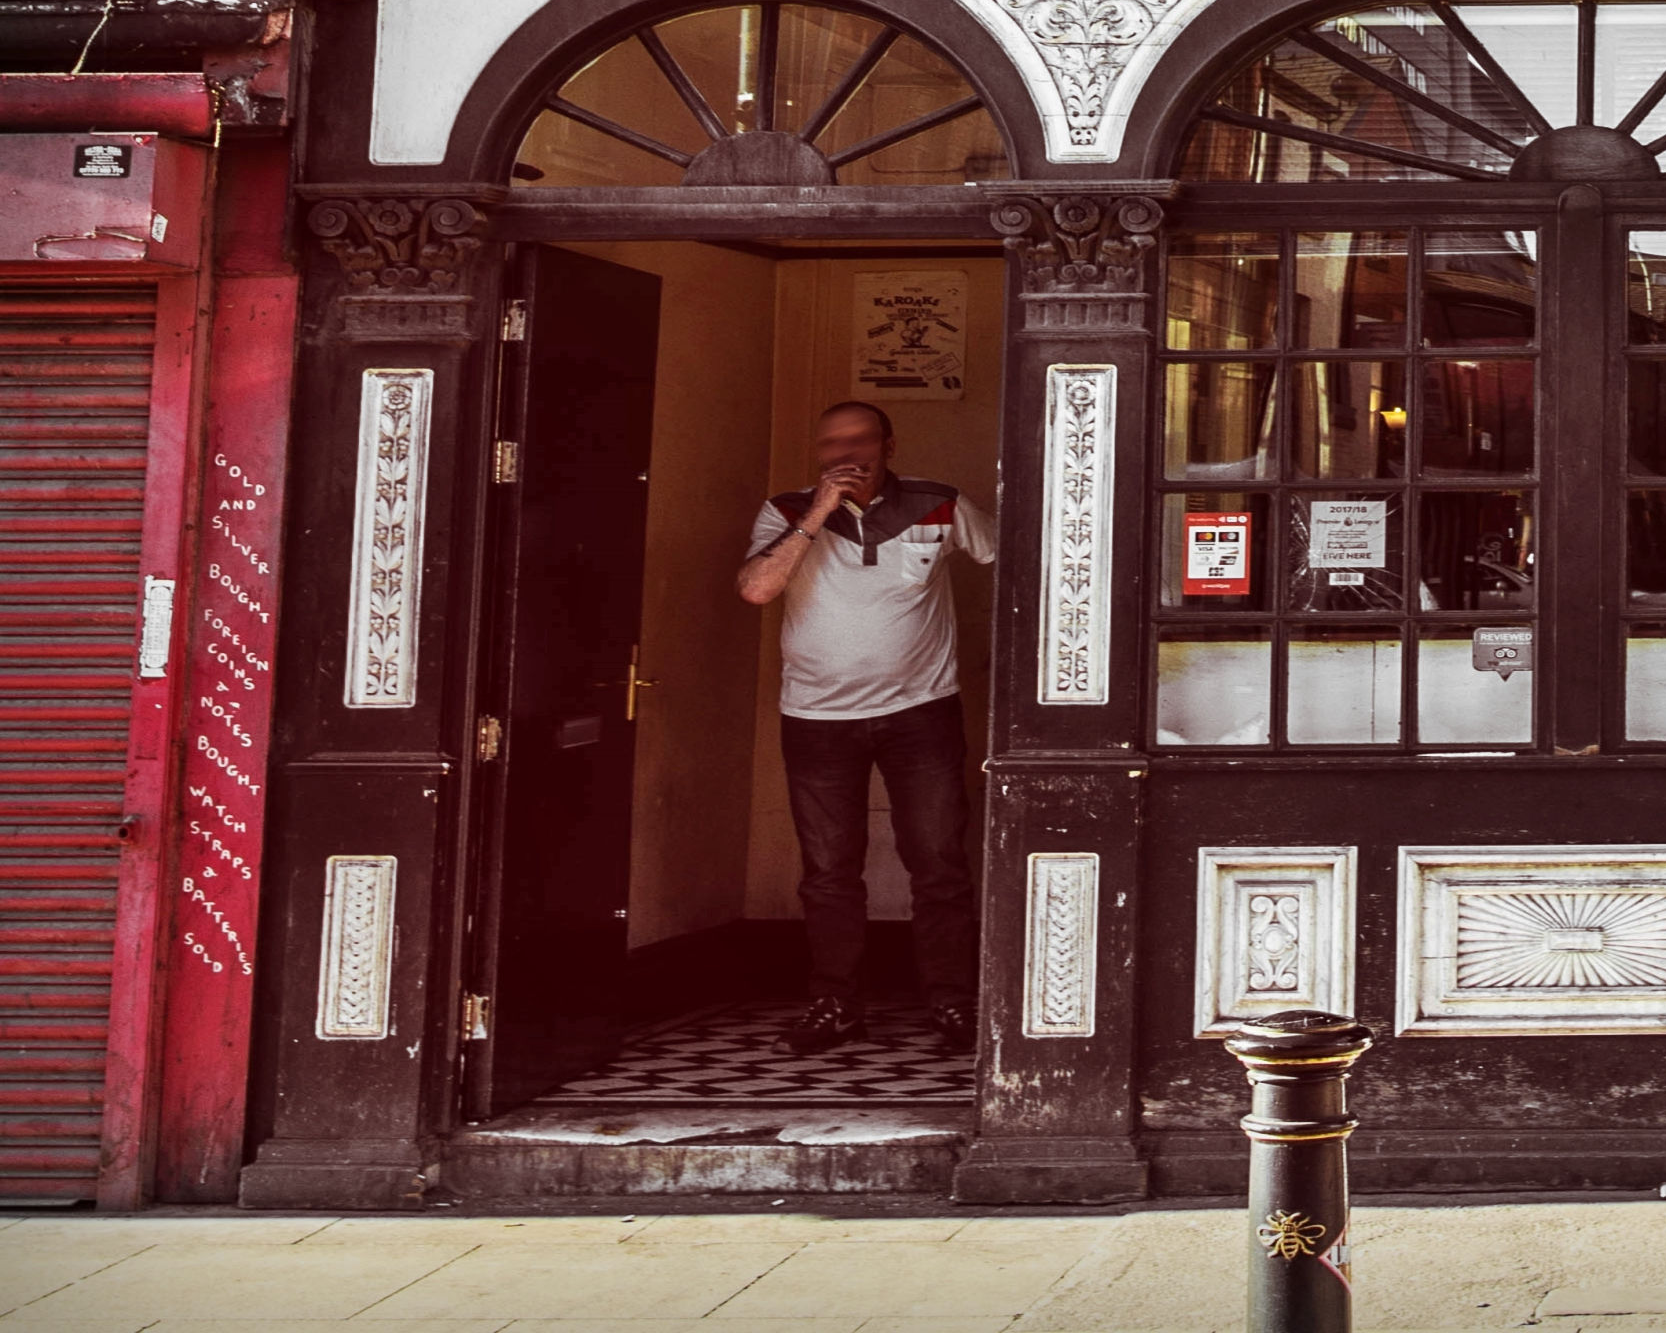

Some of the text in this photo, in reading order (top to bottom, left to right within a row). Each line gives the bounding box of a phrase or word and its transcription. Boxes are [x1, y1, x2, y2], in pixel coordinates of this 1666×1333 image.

[215, 453, 266, 496] GOLD
[219, 499, 256, 510] AND
[1346, 552, 1372, 560] HERE
[209, 563, 270, 624] BOUGHT
[204, 609, 270, 671] FOREIGN
[1479, 632, 1533, 641] REVIEWED
[207, 643, 256, 690] COINS
[200, 696, 253, 747] NOTES
[197, 734, 261, 796] BOUGHT
[189, 785, 246, 832] WATCH
[190, 820, 252, 879] STRAPS
[182, 877, 252, 975] BATTERIES
[184, 932, 223, 973] SOLD
